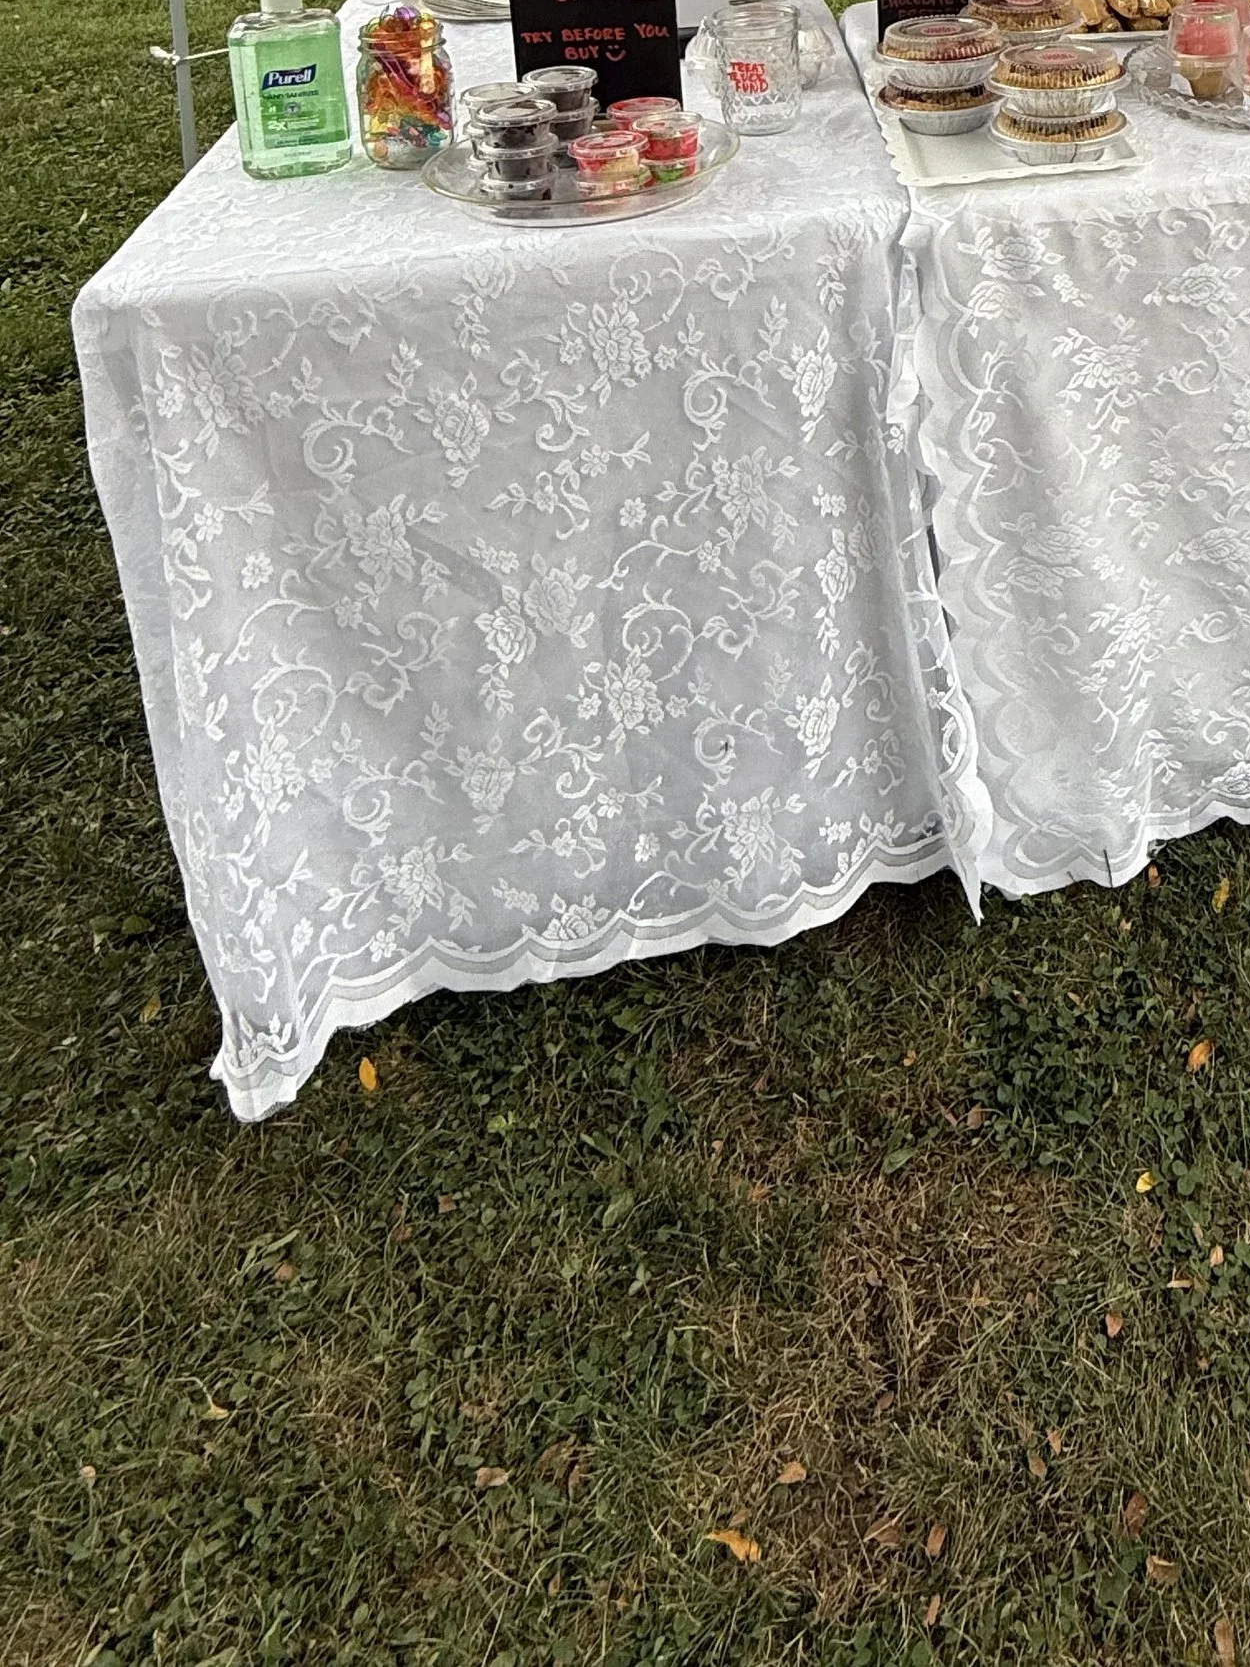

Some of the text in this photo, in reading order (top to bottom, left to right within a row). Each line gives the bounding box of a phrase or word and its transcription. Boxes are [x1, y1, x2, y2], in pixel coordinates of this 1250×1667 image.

[520, 23, 670, 44] TRY BEFORE YOU
[564, 45, 599, 60] BUY
[268, 69, 312, 85] Purell
[735, 79, 769, 94] FUND
